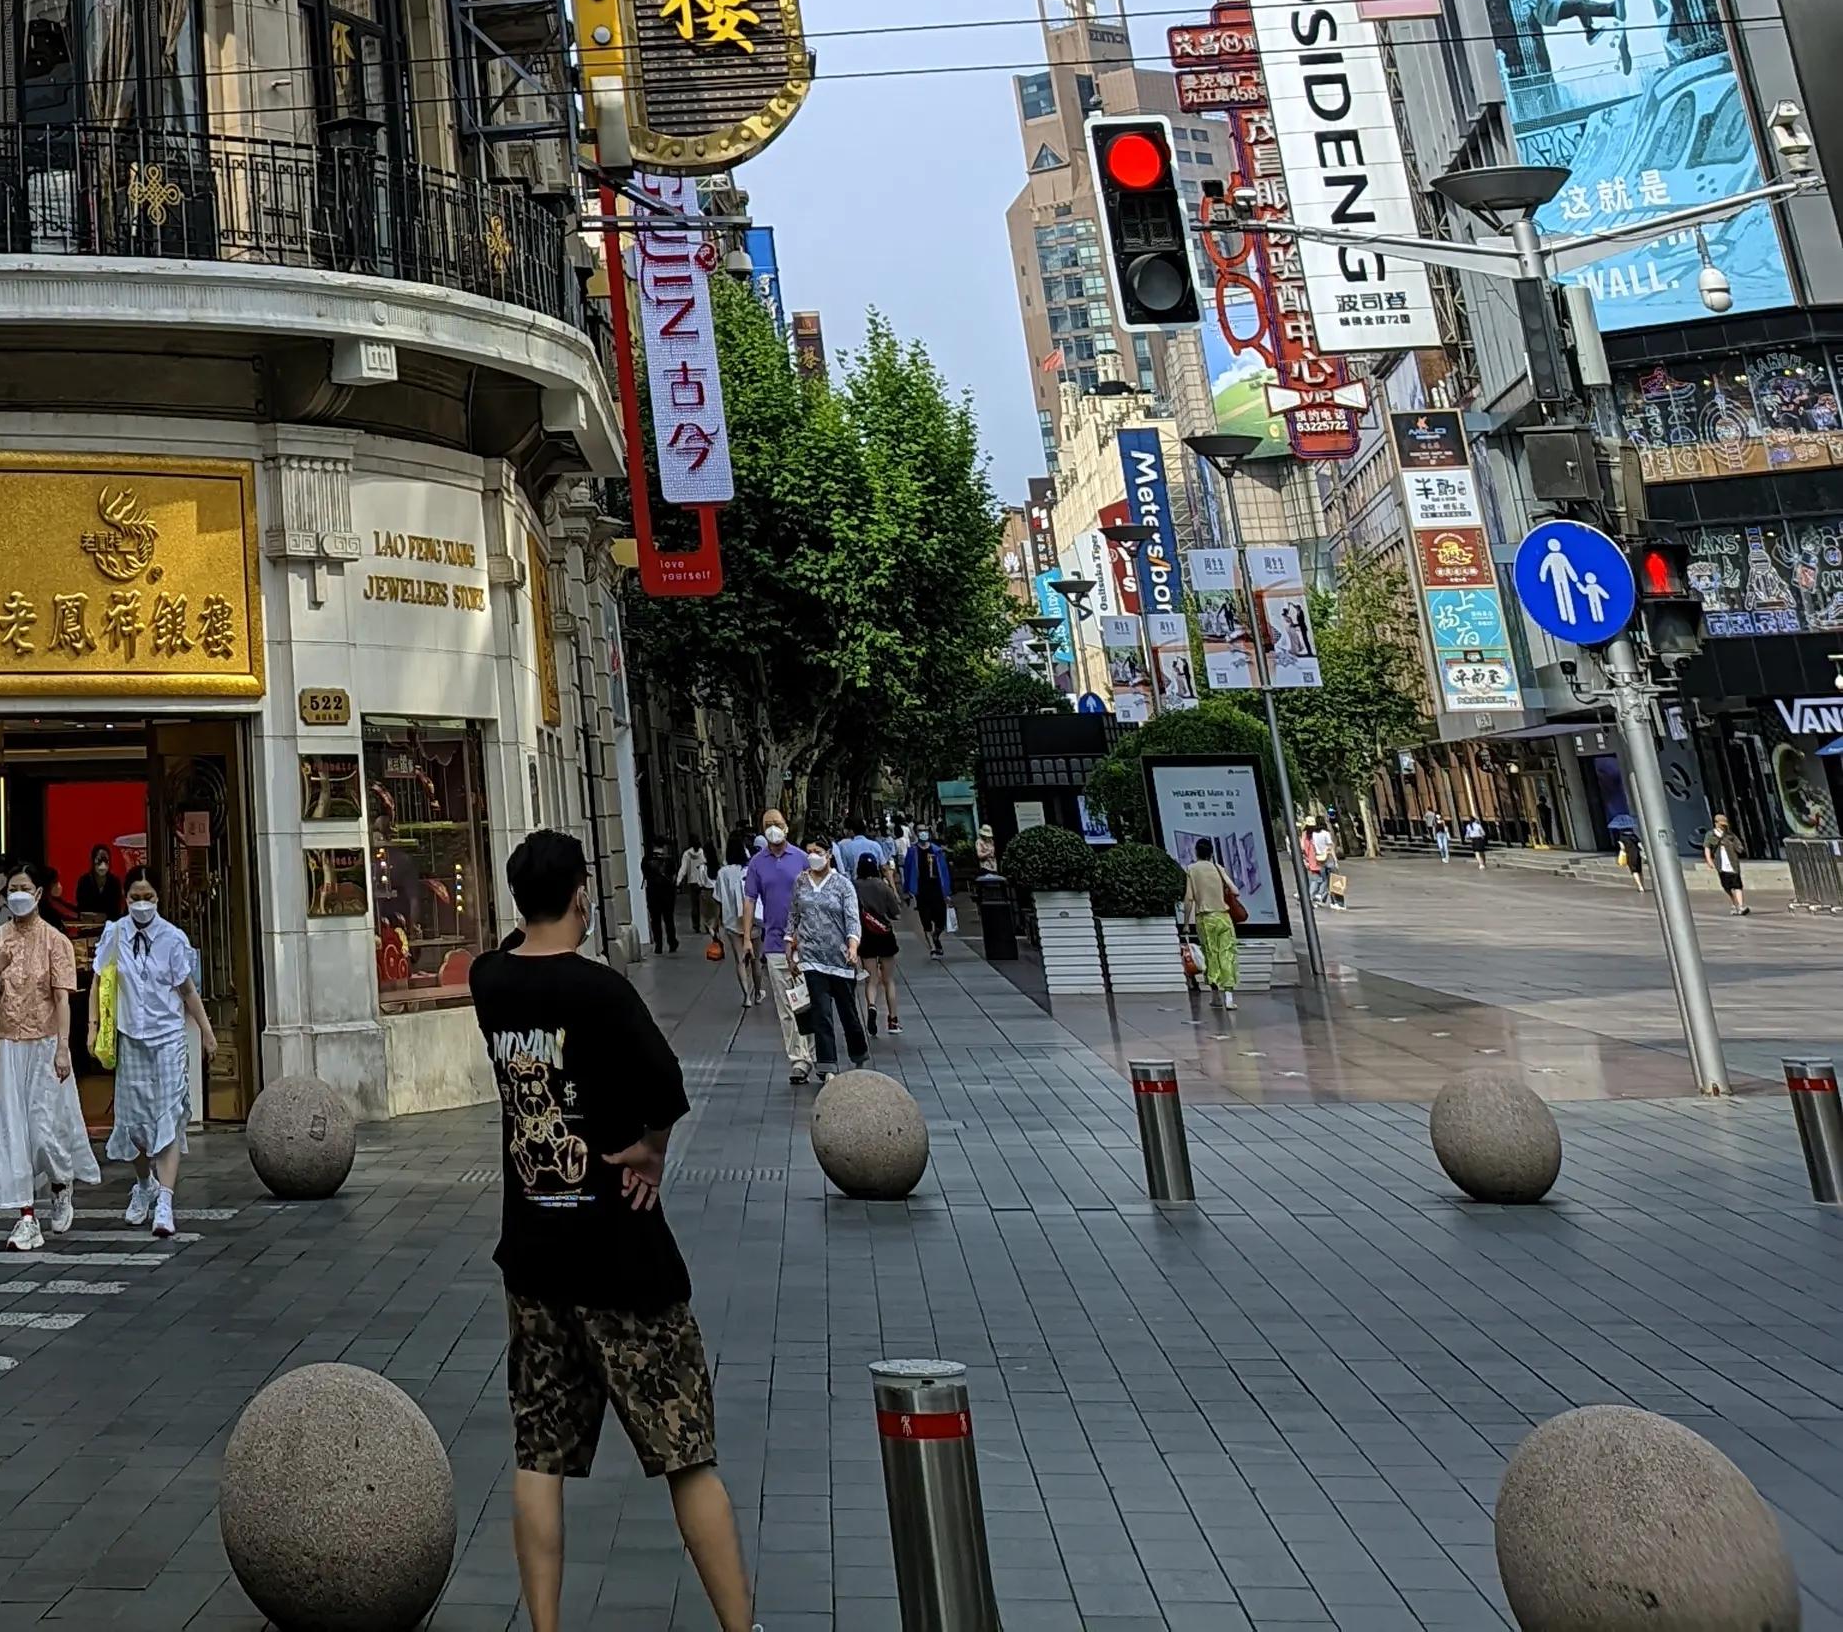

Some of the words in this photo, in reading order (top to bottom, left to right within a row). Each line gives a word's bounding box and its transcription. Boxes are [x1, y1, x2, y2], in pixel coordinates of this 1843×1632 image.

[1559, 169, 1671, 222] 这就是
[1336, 291, 1408, 313] 波司登
[1302, 389, 1335, 404] VIP
[663, 360, 719, 472] 古今
[1294, 409, 1347, 423] 预约电话
[1295, 420, 1349, 432] 63225722
[373, 530, 406, 558] LAO
[407, 535, 443, 563] FENG
[443, 539, 476, 568] XIANG
[659, 558, 686, 569] love
[661, 569, 713, 582] yourself
[363, 574, 449, 608] JEWELLERS
[453, 584, 486, 612] STORE
[309, 694, 344, 711] 522
[1773, 696, 1843, 734] VAN
